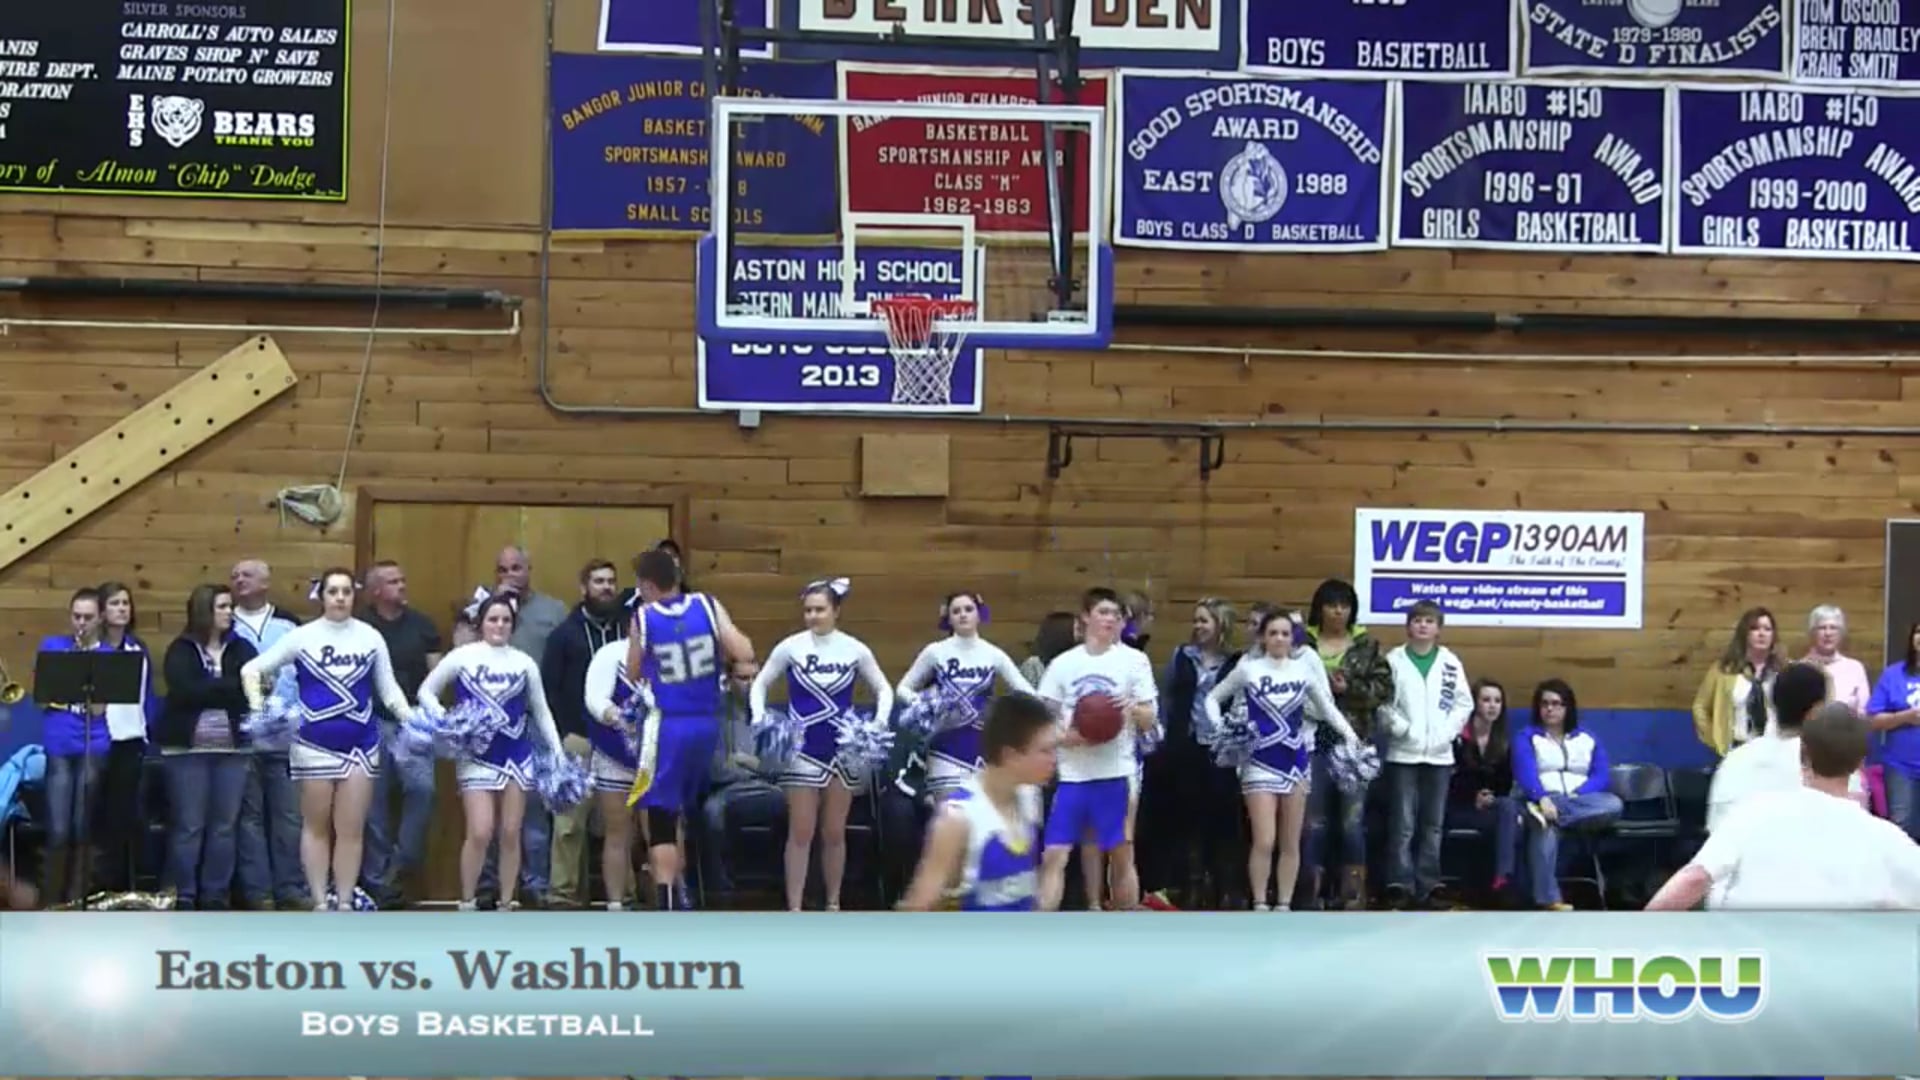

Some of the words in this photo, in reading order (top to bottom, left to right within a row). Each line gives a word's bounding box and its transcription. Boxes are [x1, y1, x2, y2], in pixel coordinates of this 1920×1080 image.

[123, 3, 168, 16] SILVER
[175, 4, 246, 19] SPONSORS
[1841, 0, 1900, 24] OSGOOD
[121, 22, 219, 41] CARROLL'S
[225, 26, 274, 42] AUTO
[279, 27, 338, 45] SALES
[1530, 3, 1608, 59] STATE
[1618, 45, 1636, 64] D
[1648, 4, 1781, 65] FINALISTS
[1613, 27, 1702, 43] 1979-1980
[1801, 25, 1848, 51] BRENT
[1853, 26, 1920, 52] BRADLEY
[119, 44, 188, 62] GRAVES
[194, 46, 242, 63] SHOP
[275, 50, 320, 66] SAVE
[1268, 37, 1325, 66] BOYS
[1357, 40, 1490, 69] BASKETBALL
[1800, 51, 1843, 78] CRAIG
[1848, 52, 1898, 79] SMITH
[44, 62, 98, 79] DEPT.
[116, 64, 176, 82] MAINE
[182, 67, 248, 84] POTATO
[252, 69, 334, 86] GROWERS
[561, 90, 622, 130] BANGOR
[627, 80, 683, 102] JUNIOR
[1464, 84, 1527, 117] IAABO
[1546, 87, 1602, 118] #150
[1740, 91, 1804, 123] IAABO
[1825, 95, 1879, 127] #150
[213, 111, 315, 137] BEARS
[643, 118, 746, 138] BASKETL
[925, 123, 1030, 142] BASKETBALL
[1127, 106, 1183, 161] GOOD
[1184, 83, 1382, 166] SPORTSMANSHIP
[1211, 116, 1300, 140] AWARD
[214, 136, 275, 147] THANK
[281, 136, 314, 147] YOU
[605, 146, 709, 166] SPORTSMANSH
[878, 147, 1011, 166] SPORTSMANSHIP
[1403, 119, 1573, 198] SPORTSMANSHIP
[1593, 132, 1663, 205] AWARD
[1681, 125, 1854, 207] SPORTSMANSHIP
[36, 158, 58, 184] of
[76, 160, 157, 183] Almon
[250, 164, 316, 189] Dodge
[647, 176, 687, 193] 1957
[934, 173, 983, 190] CLASS
[1143, 169, 1214, 192] EAST
[1295, 173, 1348, 195] 1988
[923, 197, 1031, 214] 1962-1963
[1749, 177, 1868, 213] 1999-2000
[627, 203, 680, 222] SMALL
[690, 206, 763, 225] SCOLS
[1422, 207, 1481, 239] GIRLS
[1516, 210, 1641, 243] BASKETBALL
[1136, 219, 1173, 237] BOYS
[1182, 222, 1229, 239] CLASS
[1244, 223, 1255, 240] D
[1272, 224, 1365, 241] BASKETBALL
[1702, 215, 1761, 248] GIRLS
[1785, 217, 1912, 251] BASKETBALL
[733, 259, 806, 281] ASTON
[877, 261, 961, 283] SCHOOL
[803, 291, 856, 318] MAIN
[801, 365, 880, 387] 2013
[1371, 520, 1511, 564] WEGP
[1513, 524, 1627, 553] 1390AM
[1411, 583, 1447, 595] Watch
[1450, 585, 1470, 595] our
[1473, 584, 1504, 596] video
[1507, 585, 1548, 597] stream
[1550, 586, 1563, 598] of
[1565, 586, 1588, 597] this
[655, 637, 717, 684] 32
